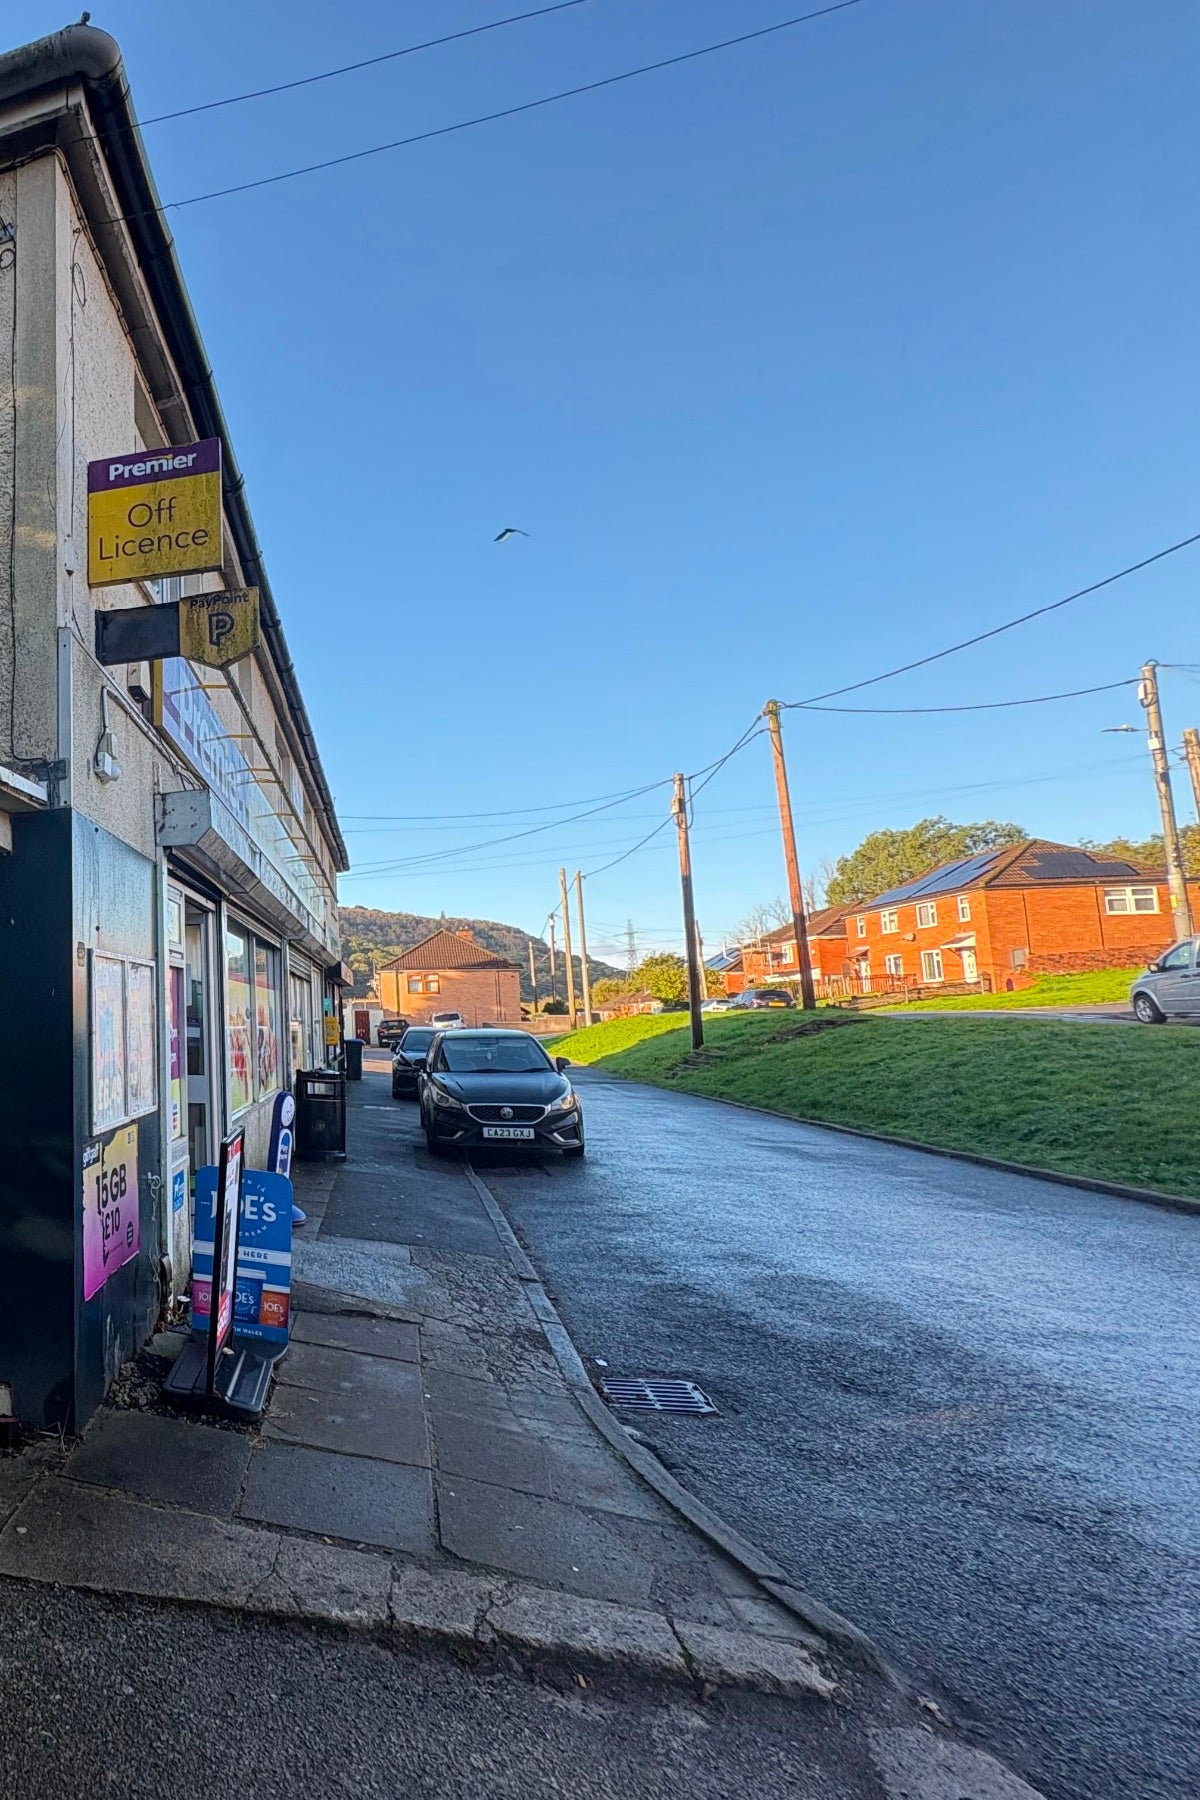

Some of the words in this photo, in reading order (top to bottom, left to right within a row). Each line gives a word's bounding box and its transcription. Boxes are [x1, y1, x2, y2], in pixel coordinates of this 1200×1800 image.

[109, 451, 197, 481] Premier
[127, 497, 177, 528] Off
[98, 528, 209, 561] Licence
[190, 592, 249, 609] PayPoint
[180, 664, 241, 813] Premier
[487, 1129, 511, 1137] CA23
[512, 1129, 531, 1138] GXJ
[210, 1191, 277, 1222] JE'S
[105, 1206, 120, 1240] £10
[243, 1251, 269, 1260] HERE
[243, 1328, 263, 1336] WALES
